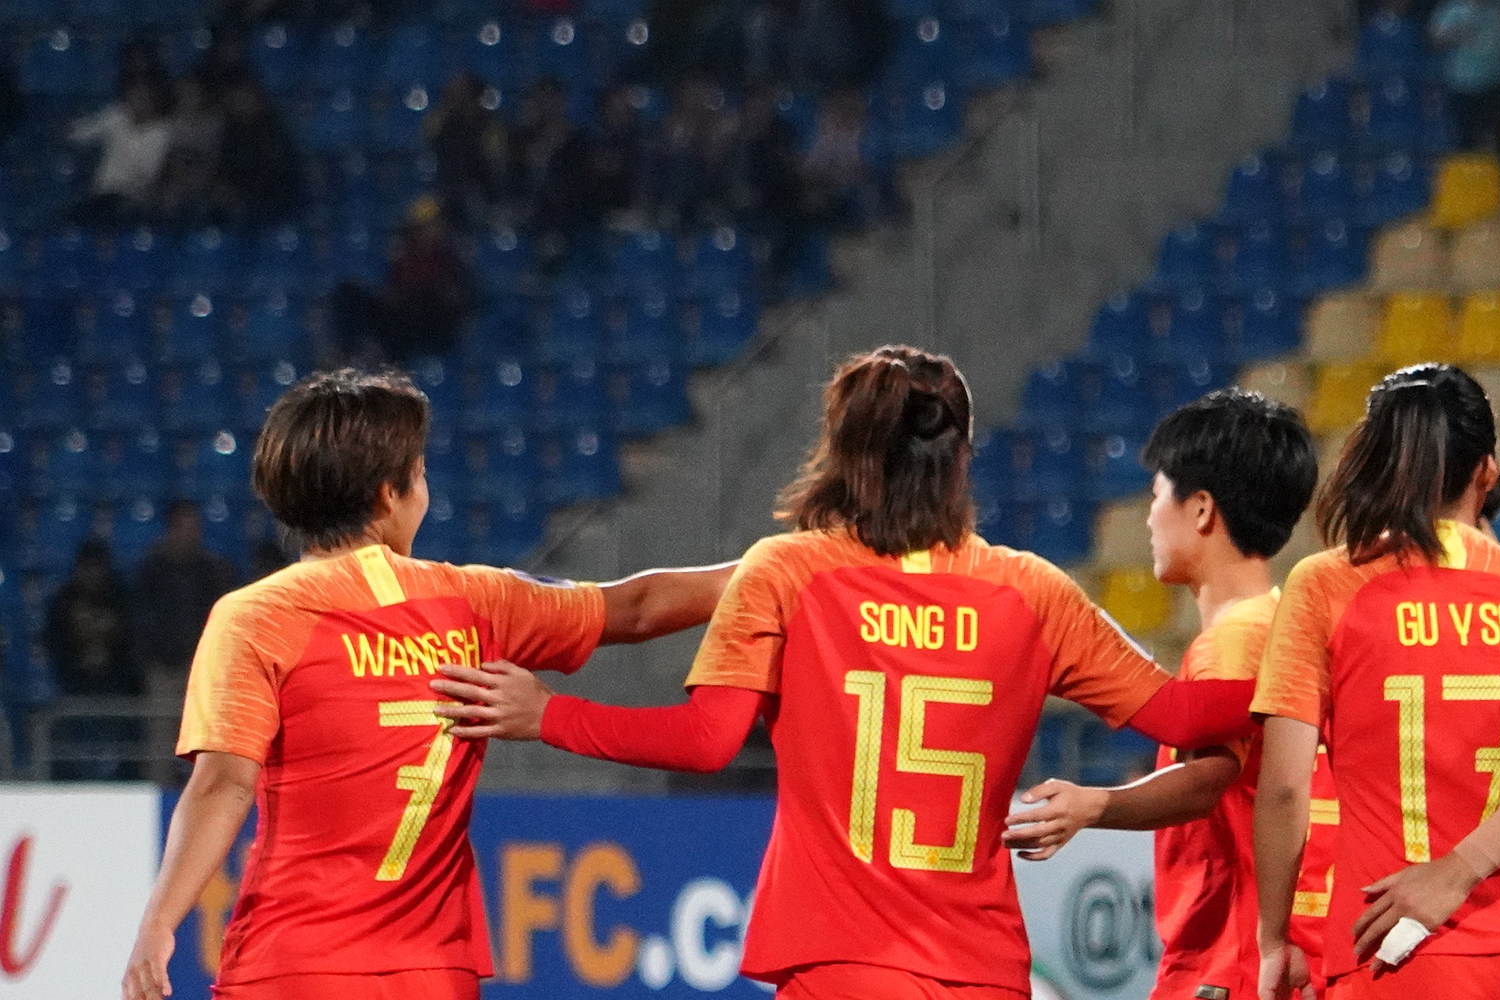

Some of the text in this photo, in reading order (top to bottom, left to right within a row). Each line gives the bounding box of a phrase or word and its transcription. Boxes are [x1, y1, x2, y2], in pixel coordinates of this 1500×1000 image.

[860, 601, 978, 652] SONG D
[1396, 602, 1439, 647] GU
[376, 700, 464, 881] 7
[845, 670, 993, 873] 15
